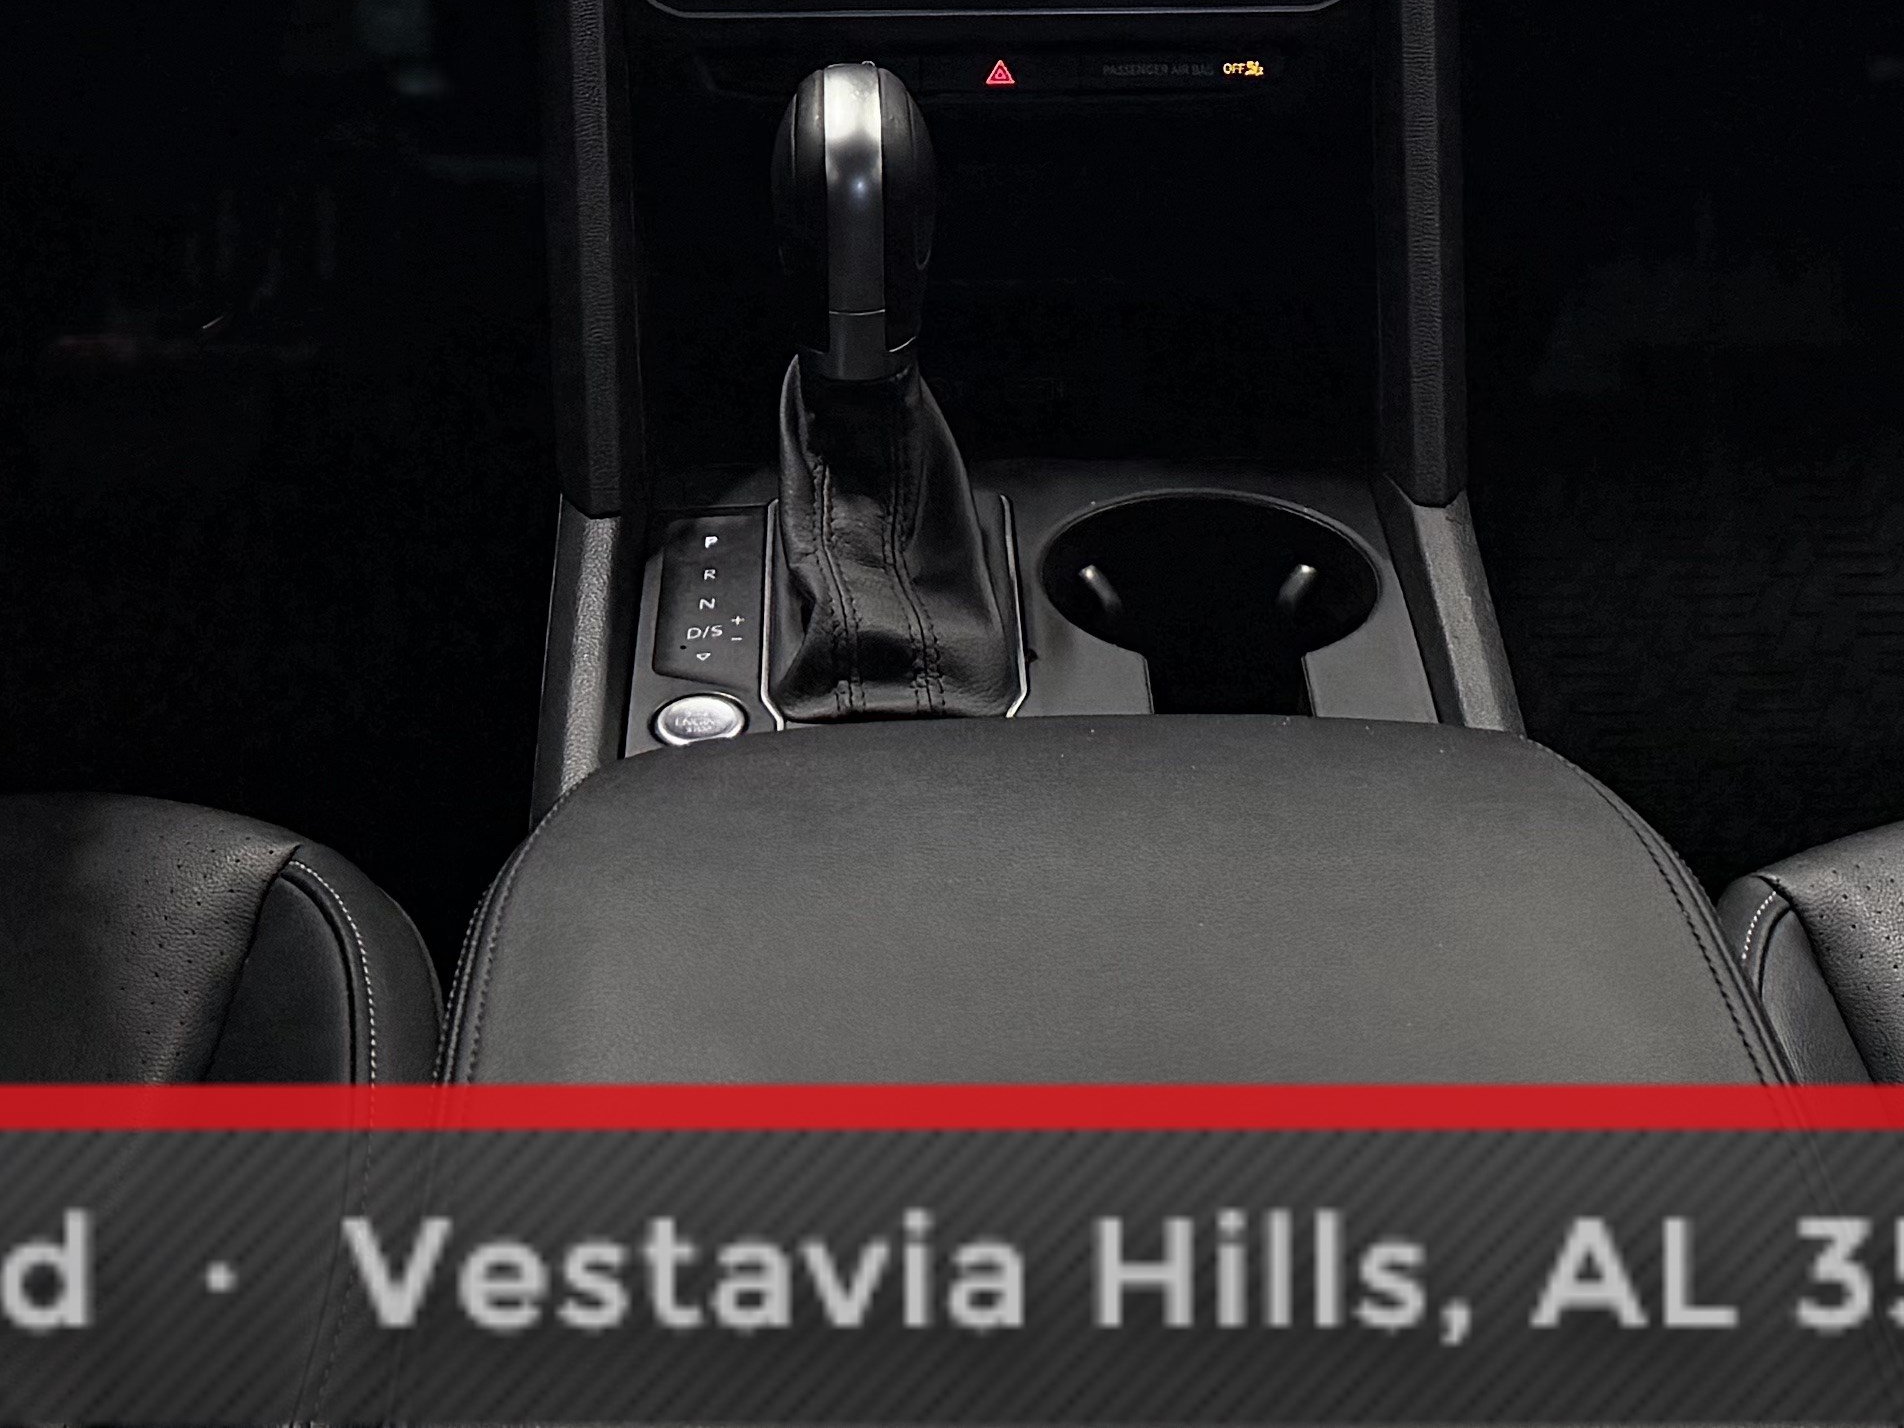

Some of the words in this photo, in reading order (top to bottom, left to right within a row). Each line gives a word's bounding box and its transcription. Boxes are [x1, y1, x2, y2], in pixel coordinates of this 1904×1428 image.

[1222, 62, 1246, 76] OFF
[703, 535, 719, 549] P
[704, 568, 717, 581] R
[698, 597, 716, 611] N
[686, 624, 725, 641] D/S
